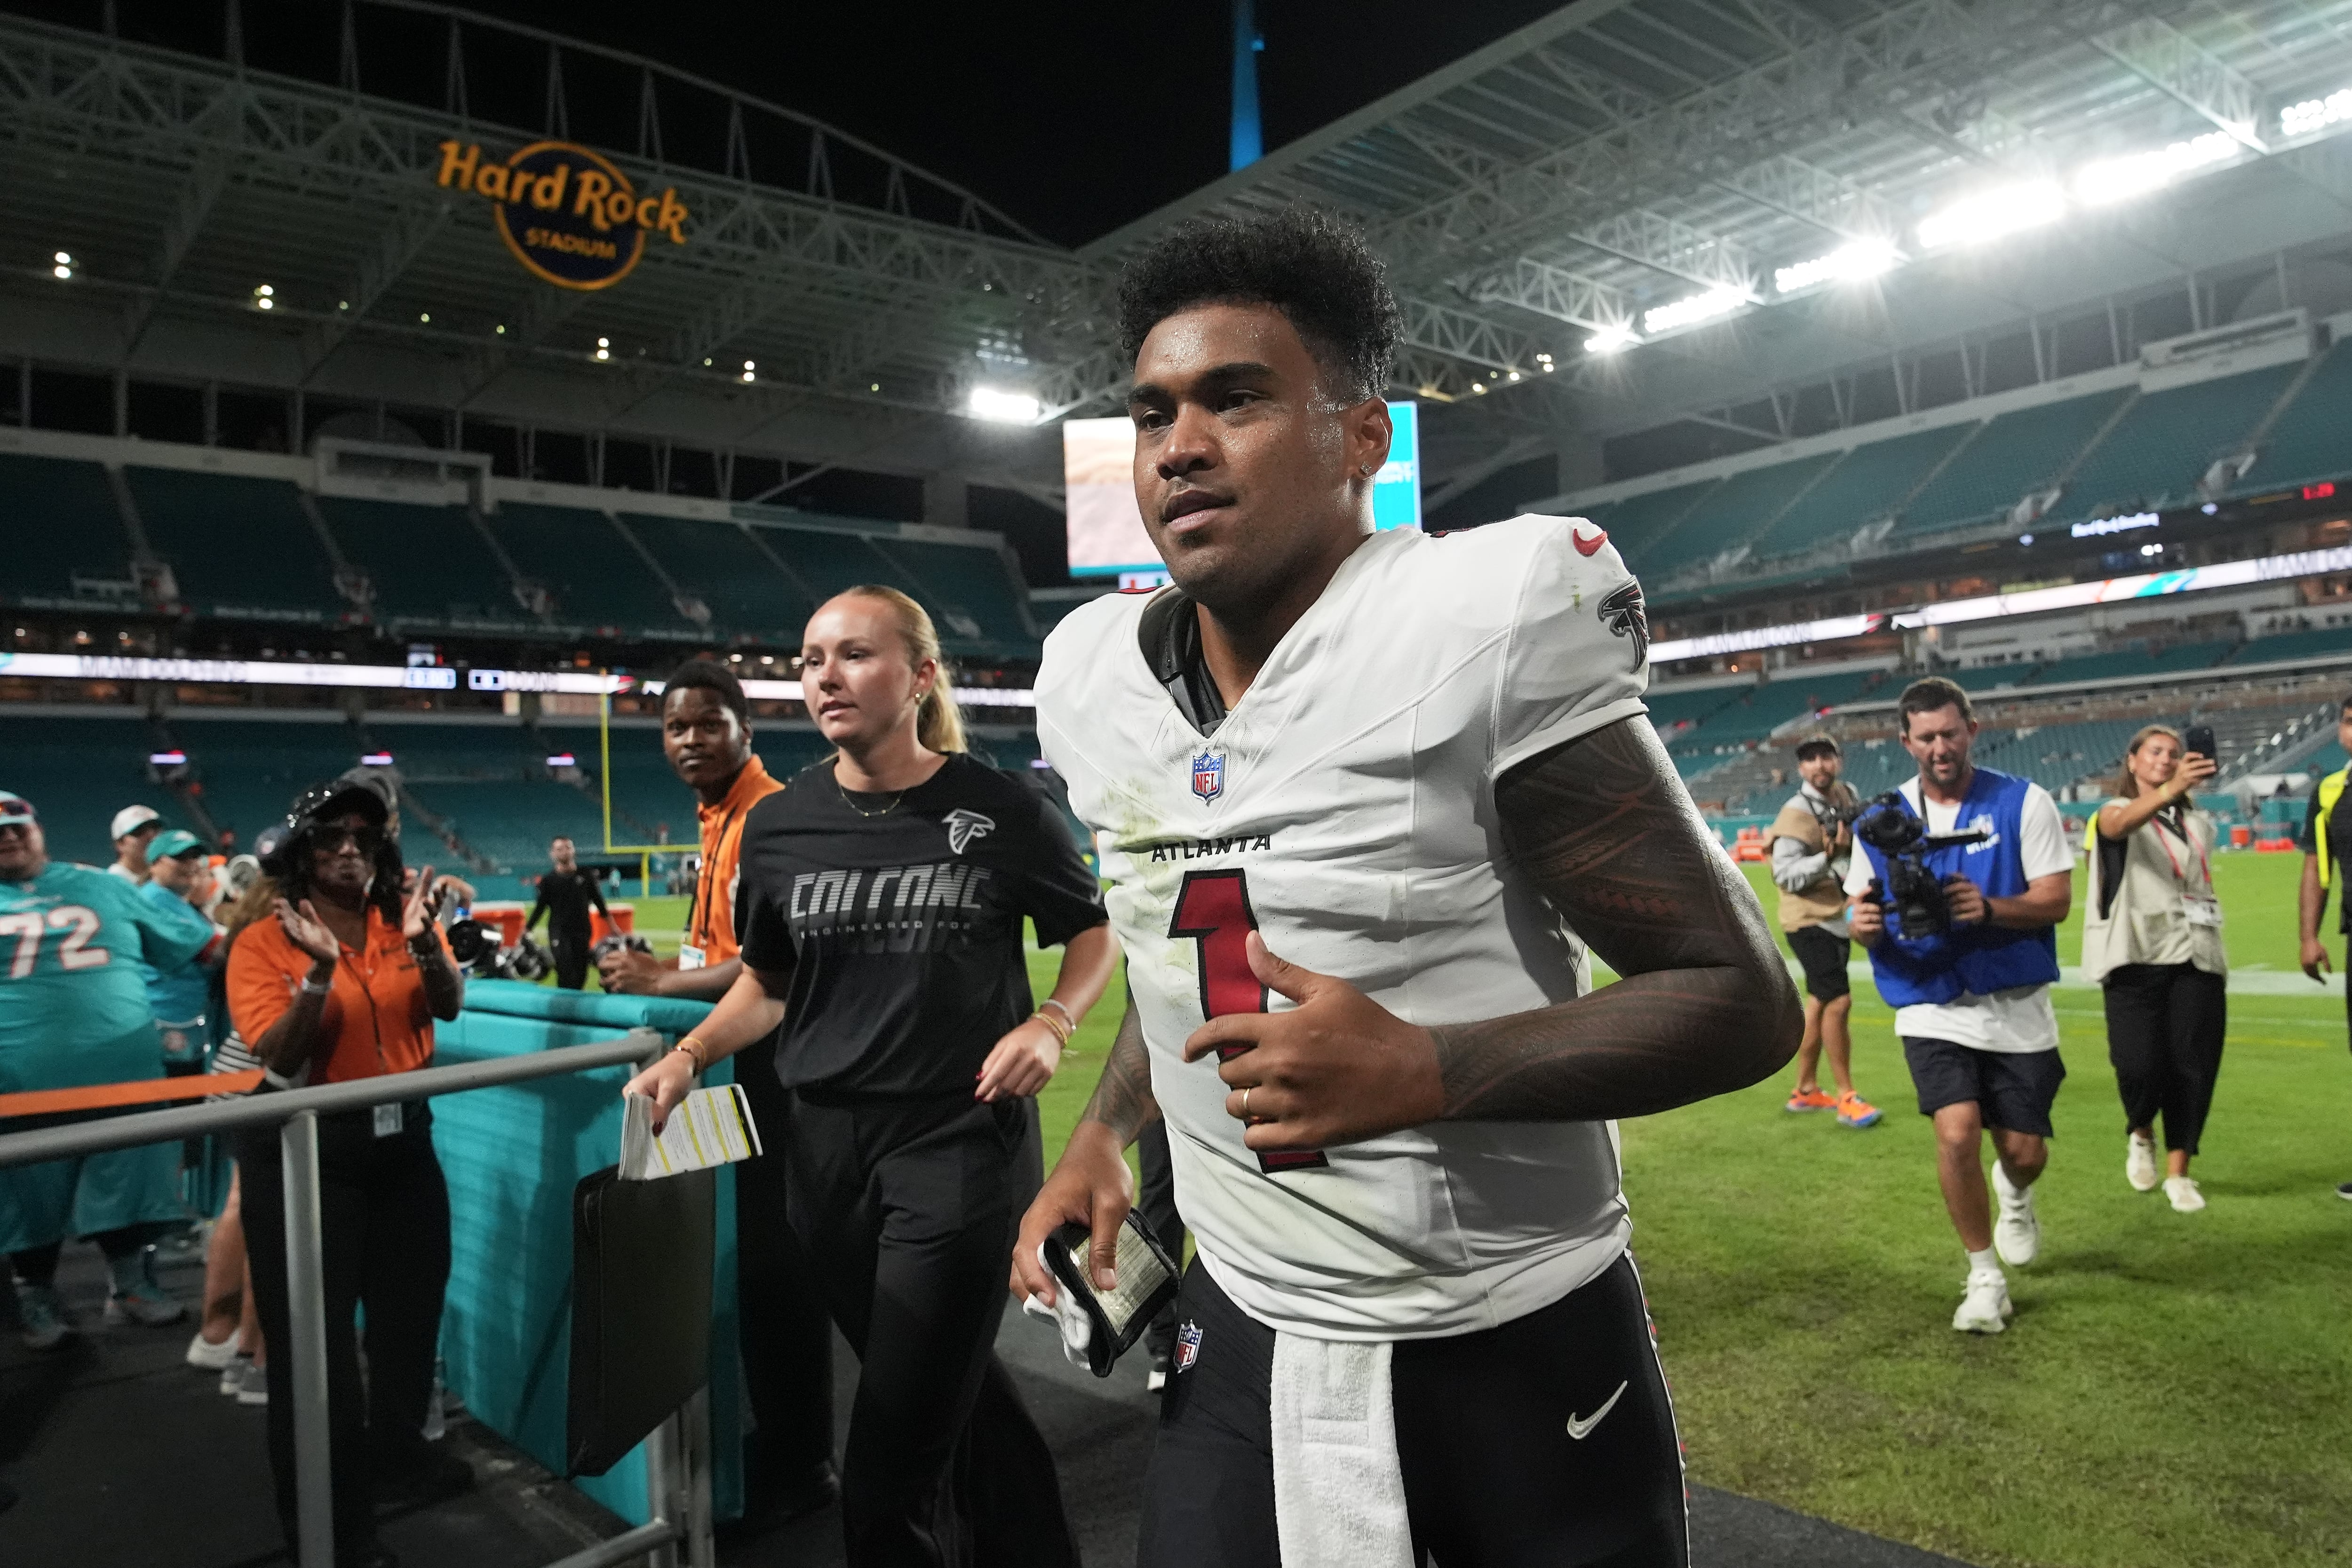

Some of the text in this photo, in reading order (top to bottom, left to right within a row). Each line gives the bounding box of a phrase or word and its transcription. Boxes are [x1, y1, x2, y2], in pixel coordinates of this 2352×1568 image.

[438, 141, 688, 245] Hard Rock
[526, 228, 616, 259] STADIUM
[1195, 773, 1217, 794] NFL
[1152, 834, 1271, 863] ATLANTA
[0, 906, 110, 979] 72
[1168, 868, 1328, 1173] 1
